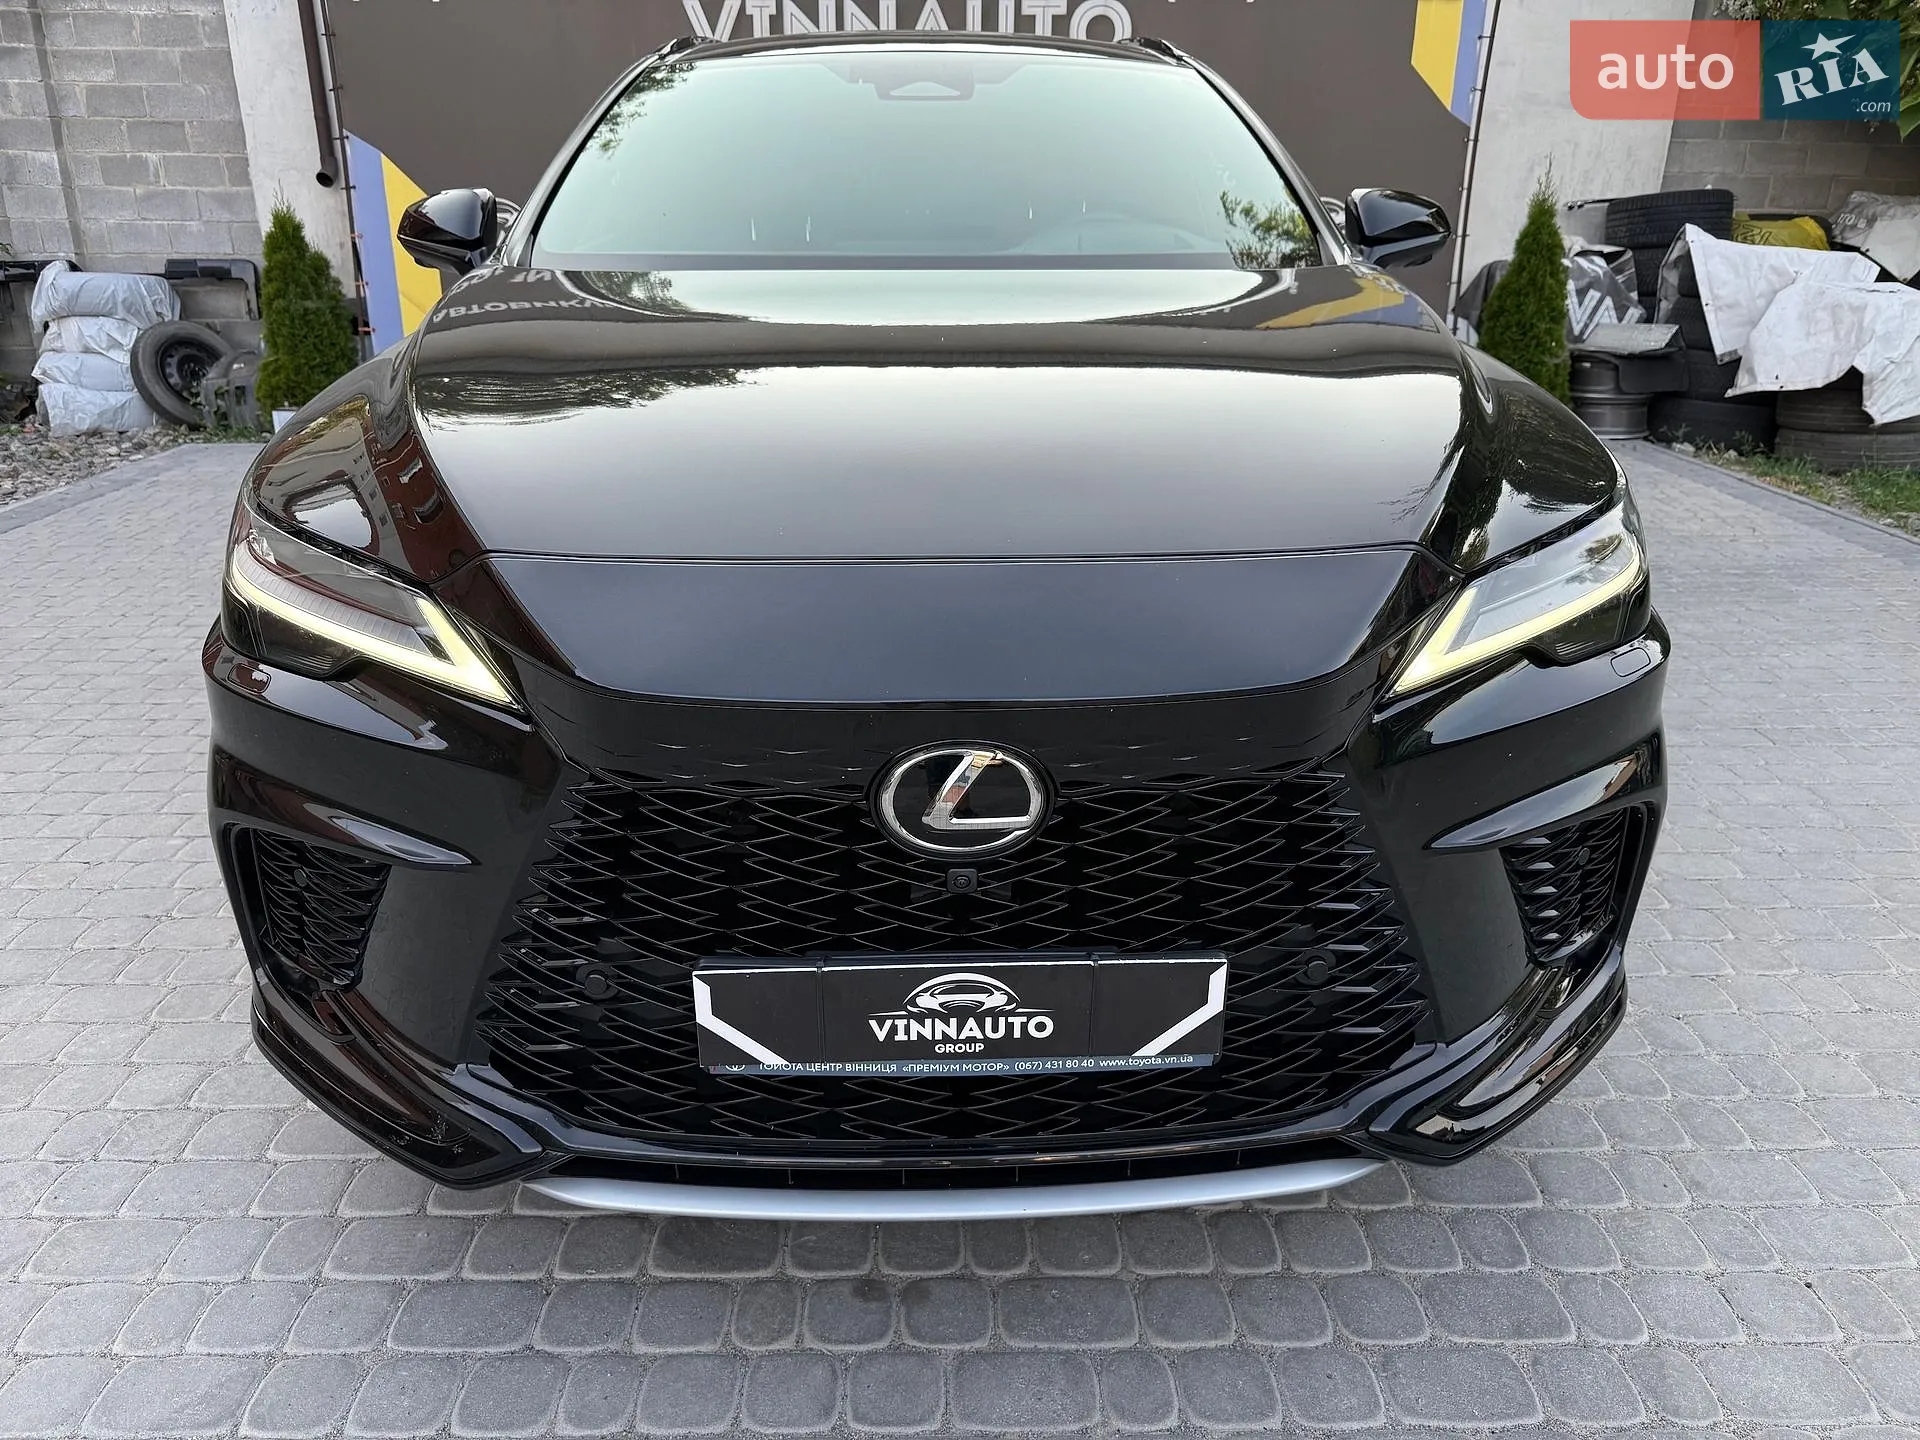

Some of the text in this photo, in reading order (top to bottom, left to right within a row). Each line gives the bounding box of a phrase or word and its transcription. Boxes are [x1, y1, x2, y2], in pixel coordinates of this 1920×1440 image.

[683, 0, 1132, 43] VINNAUTO
[868, 1015, 1054, 1042] VINNAUTO
[934, 1043, 985, 1054] GROUP
[806, 1062, 843, 1072] ЦЕНТР
[845, 1062, 897, 1072] ВІННИЦЯ
[902, 1063, 960, 1073] «ПРЕМІУМ
[962, 1062, 1010, 1072] МОТОР»
[1014, 1061, 1043, 1072] (067)
[1044, 1060, 1063, 1069] 431
[1065, 1059, 1079, 1069] 80
[1080, 1058, 1095, 1068] 40
[1099, 1055, 1194, 1067] www.toyota.vn.ua
